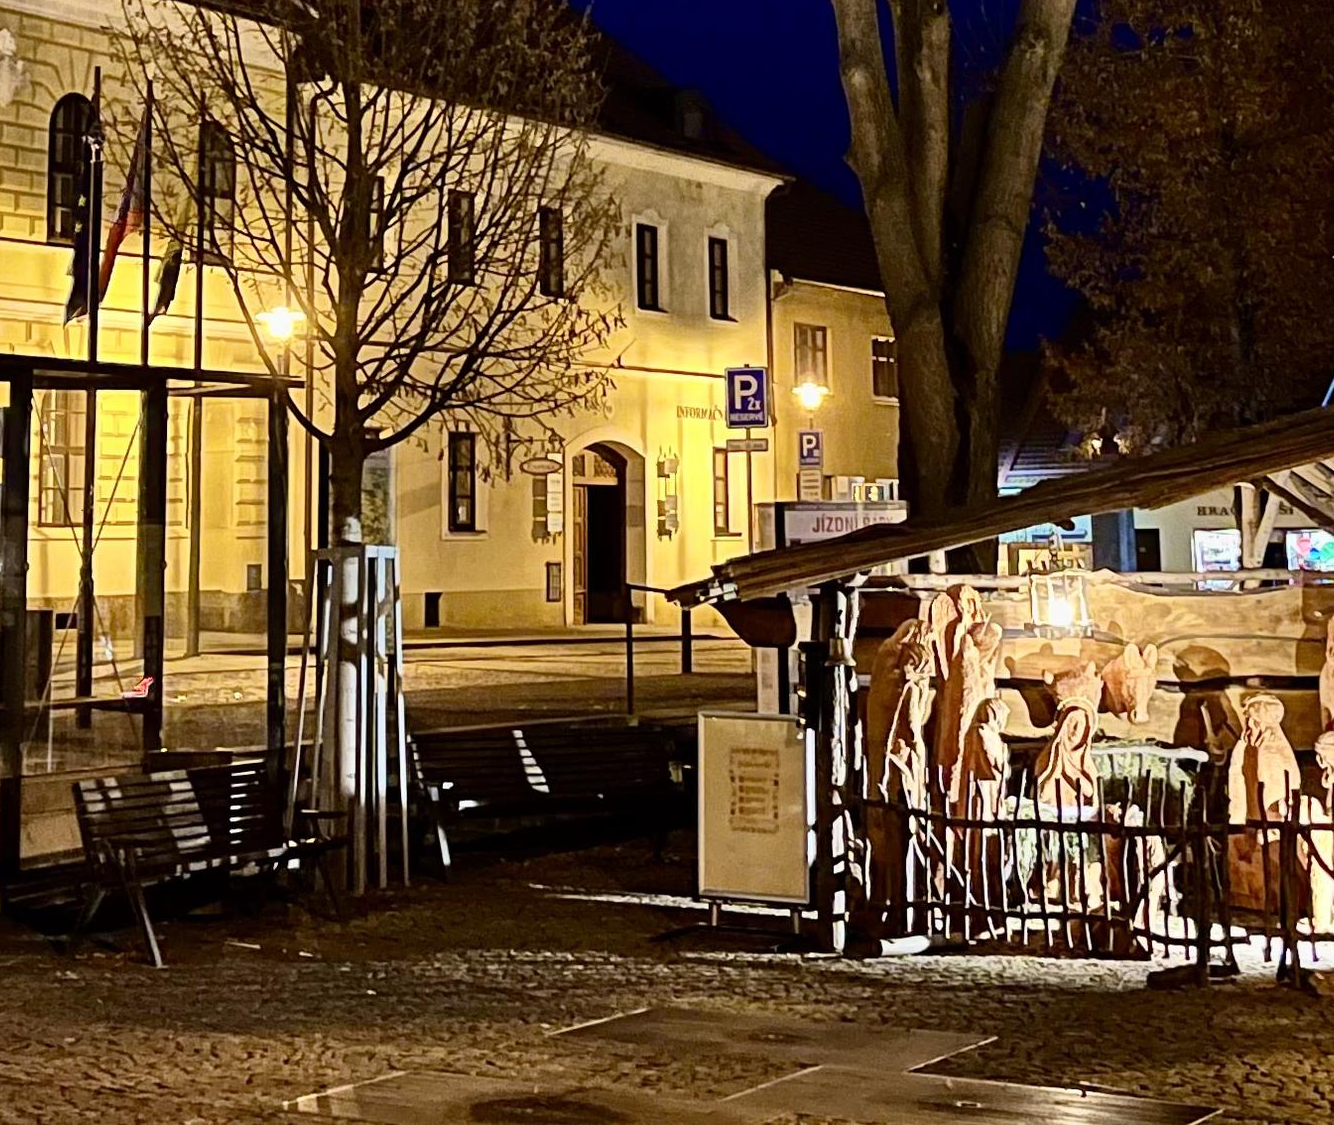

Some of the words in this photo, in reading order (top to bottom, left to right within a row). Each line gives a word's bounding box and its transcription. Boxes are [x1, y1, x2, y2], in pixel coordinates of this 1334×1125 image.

[733, 374, 758, 410] P
[747, 396, 761, 411] 2x
[802, 435, 816, 458] P
[812, 513, 858, 533] JÍZDNÍ
